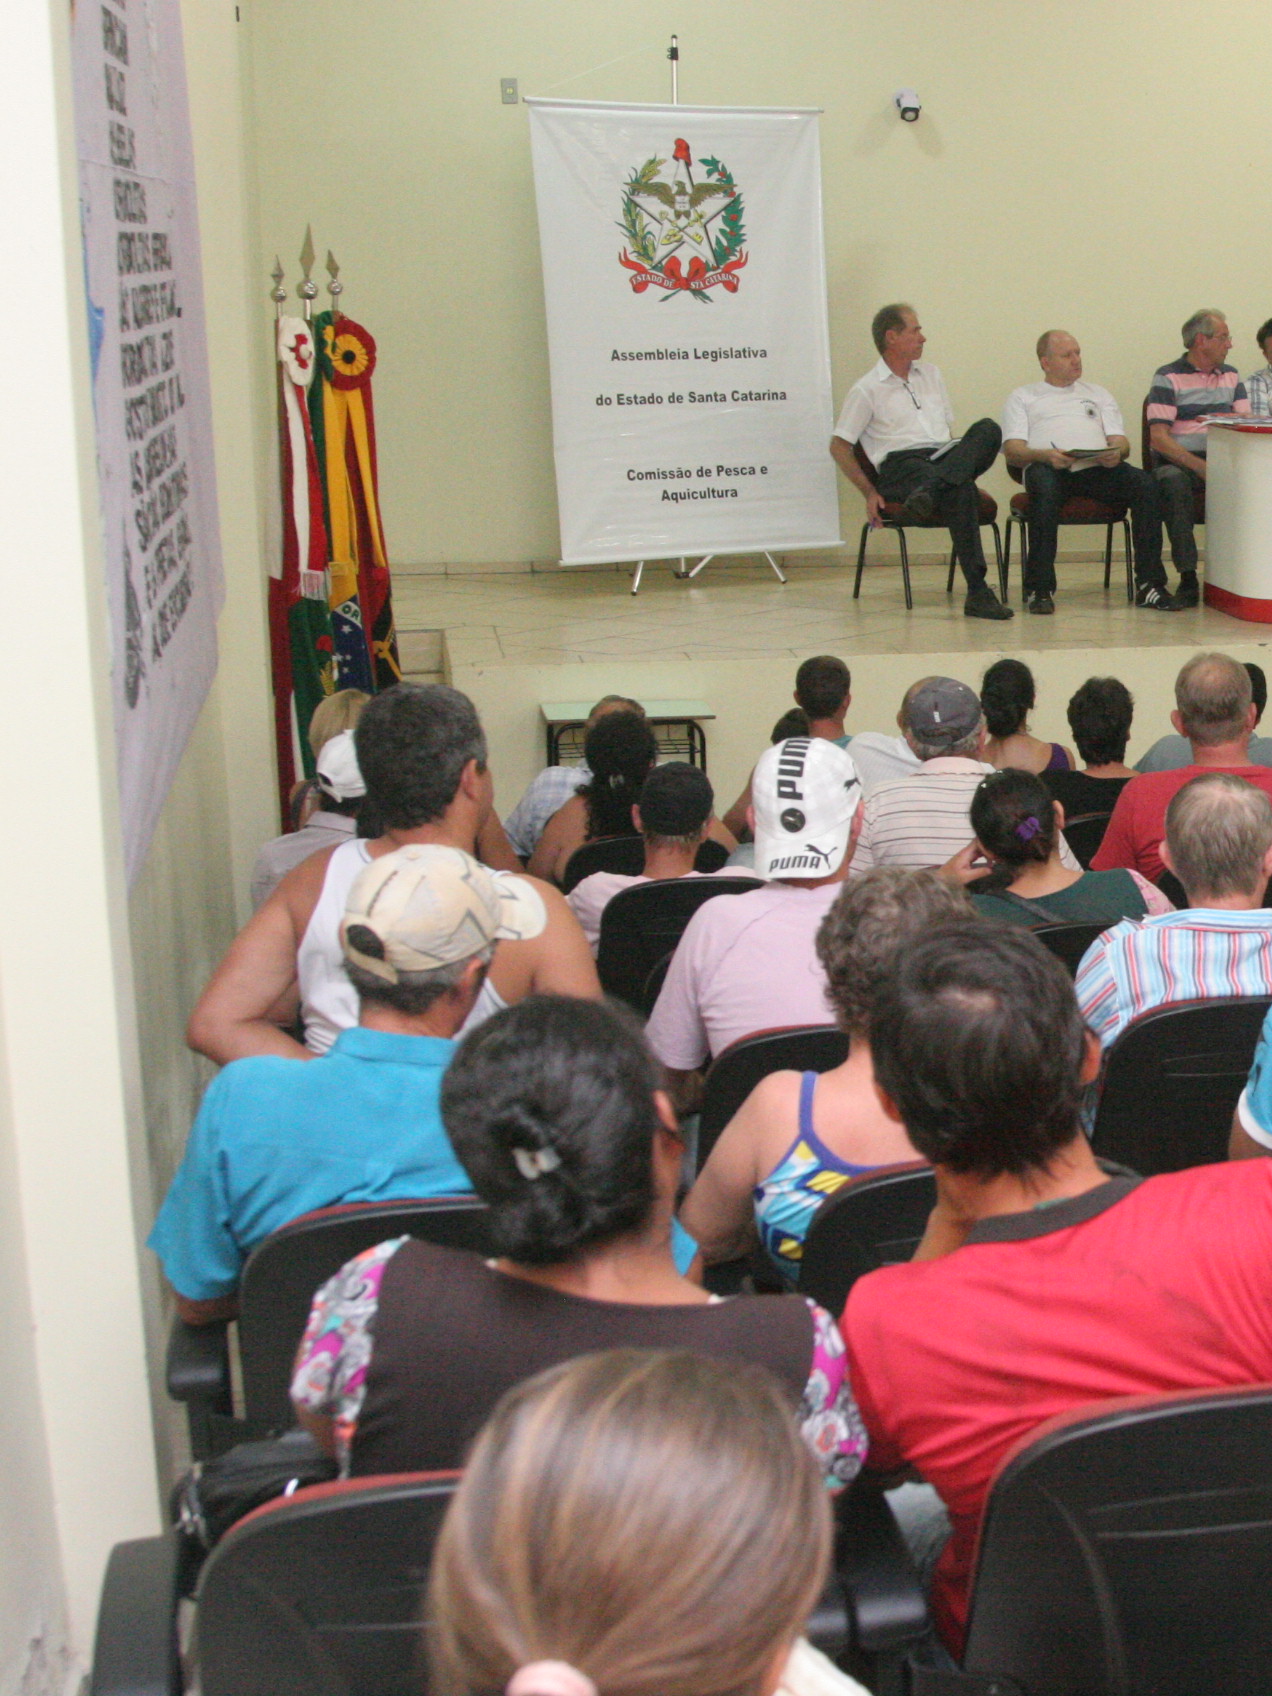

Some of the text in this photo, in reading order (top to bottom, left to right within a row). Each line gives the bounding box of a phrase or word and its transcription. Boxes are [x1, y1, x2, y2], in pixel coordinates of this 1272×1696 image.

[632, 274, 662, 285] ESTADO
[664, 279, 674, 288] DE
[611, 347, 768, 362] Assembleia Legislativa
[595, 389, 787, 407] do Estado de Santa Catarina
[626, 465, 768, 481] Comissão de Pesca e
[661, 488, 738, 503] Aquicultura
[777, 736, 812, 801] PUM
[769, 855, 821, 872] PUMA
